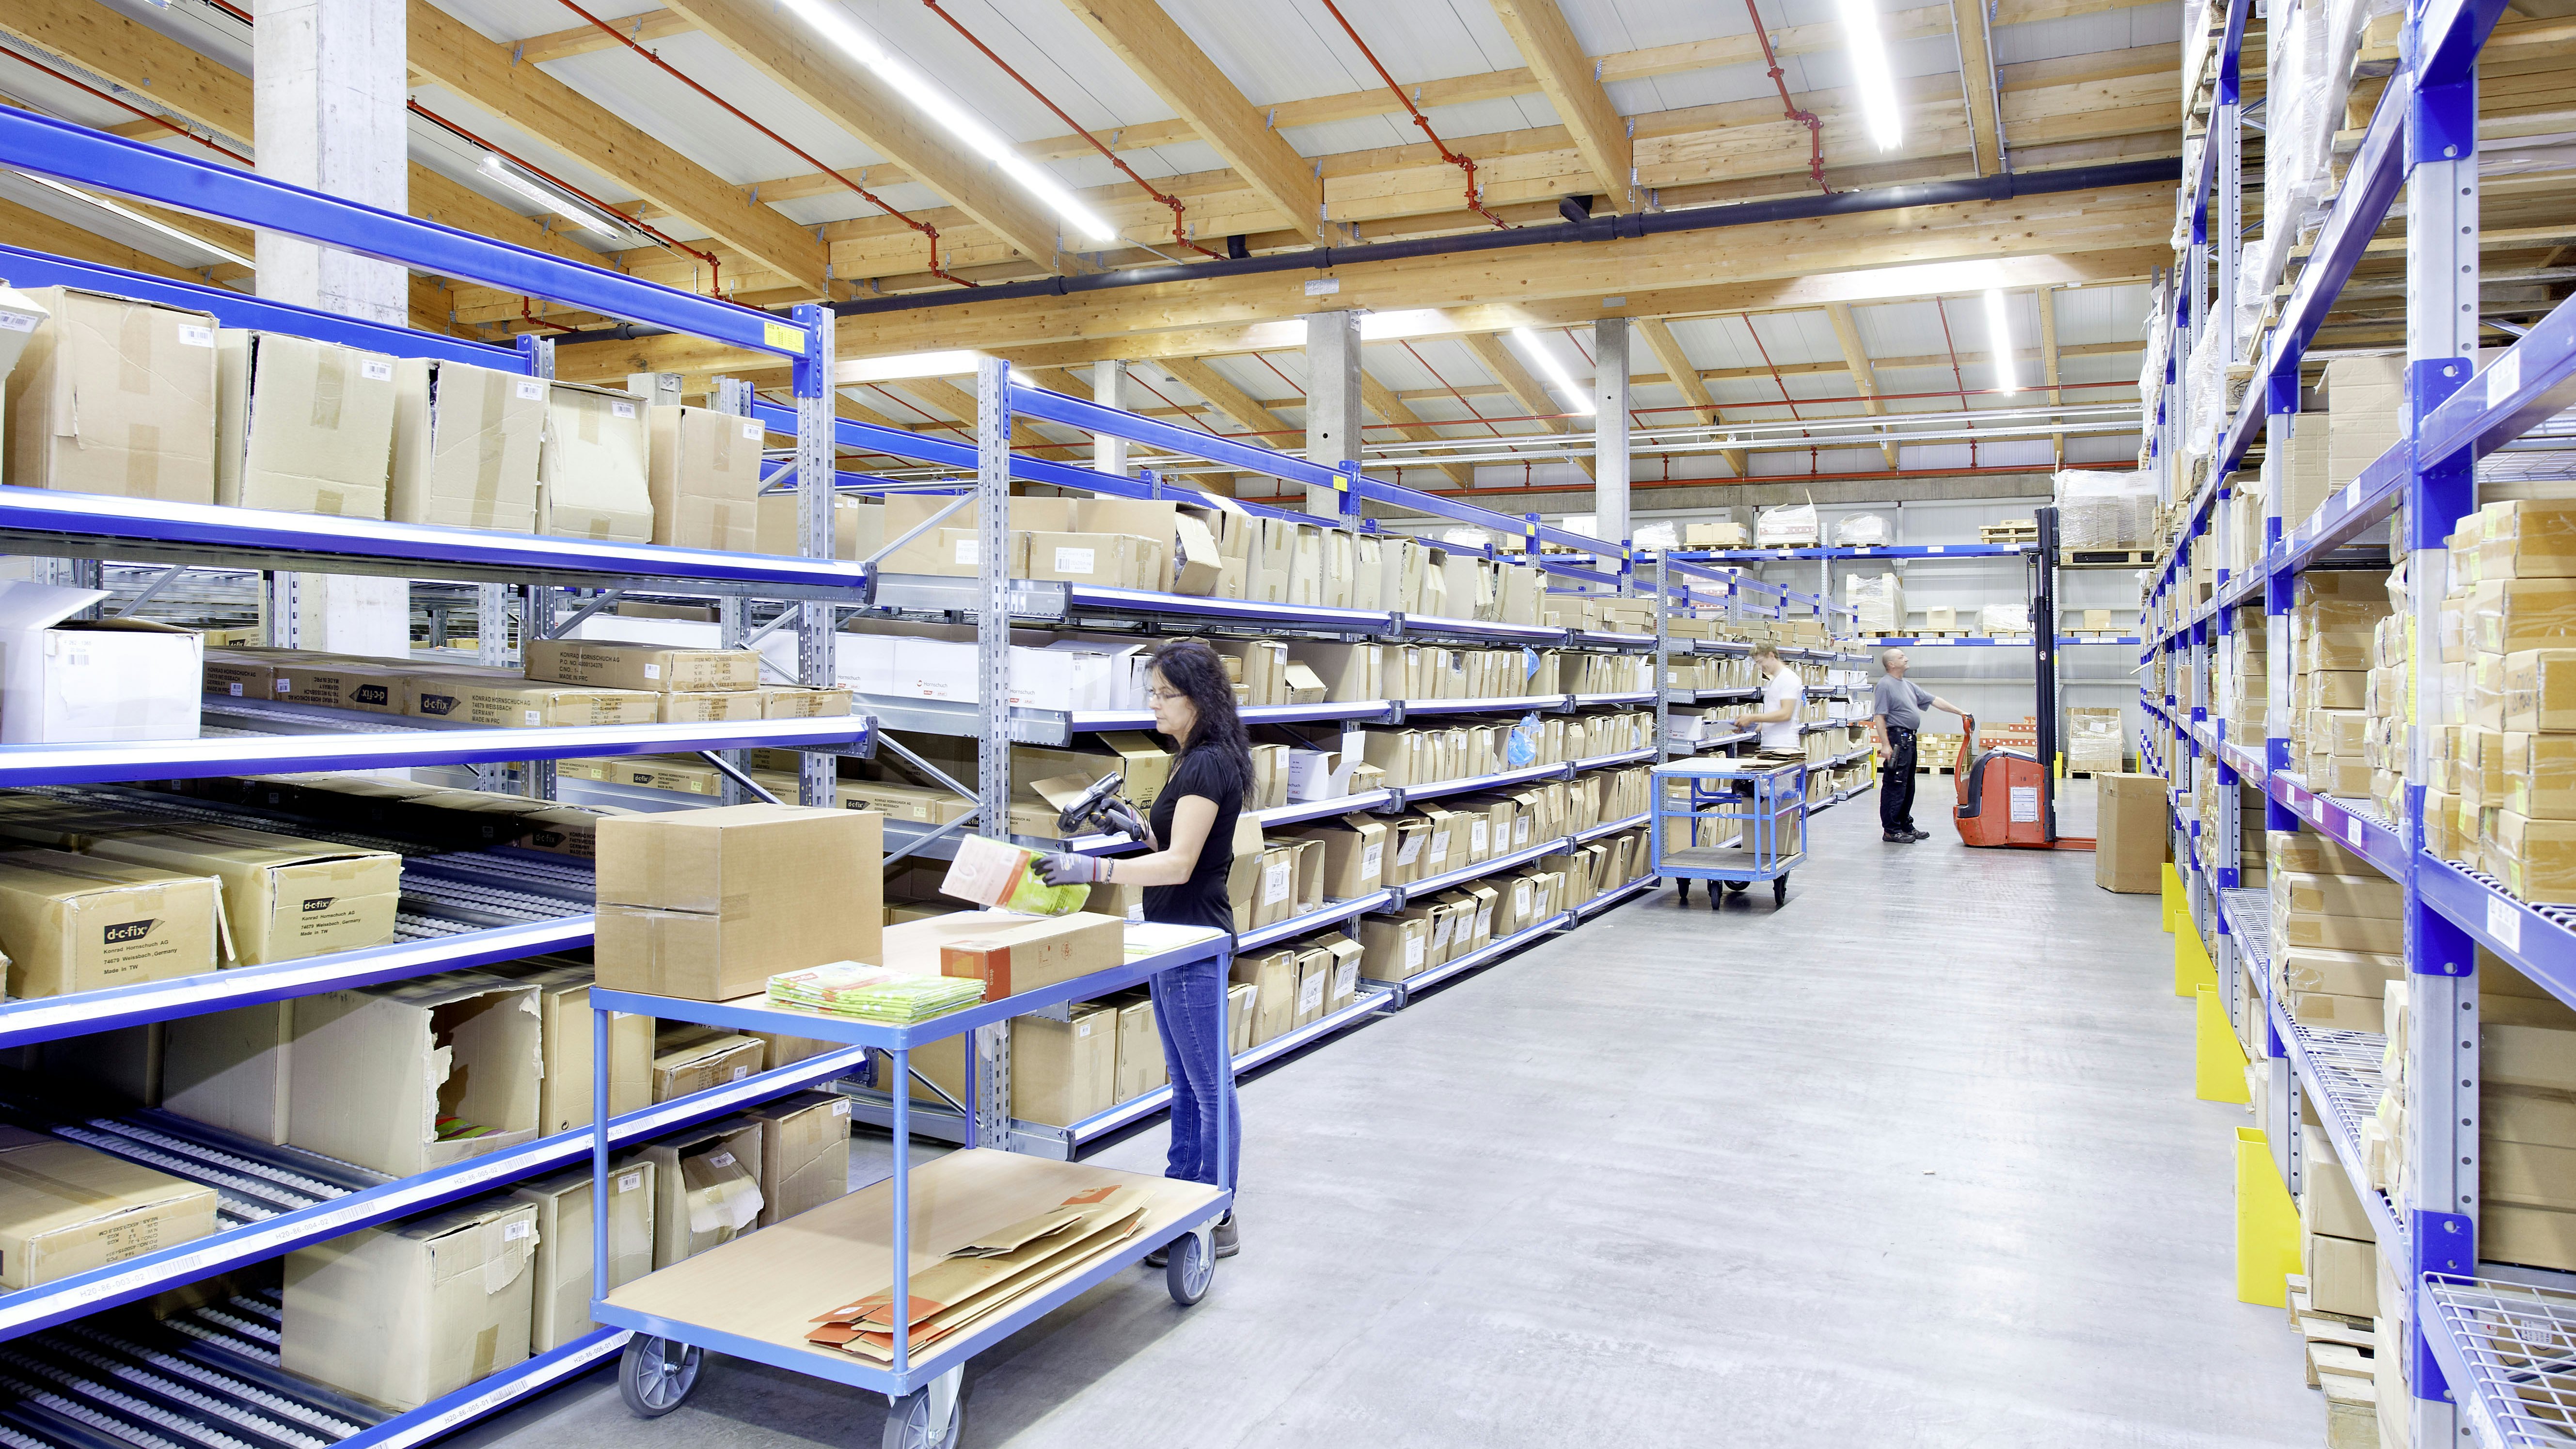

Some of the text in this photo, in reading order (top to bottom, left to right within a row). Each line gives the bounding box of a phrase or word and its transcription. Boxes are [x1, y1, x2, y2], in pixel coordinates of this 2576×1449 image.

[581, 654, 612, 662] HORNSCHUCH
[362, 689, 384, 701] d-c-fix
[424, 698, 447, 710] d-c-fix
[304, 900, 327, 909] d-c-fix
[107, 925, 145, 940] d-c-fix
[126, 942, 158, 950] Hornschuch
[454, 1167, 498, 1185] H20-86-005-02
[275, 1218, 329, 1240] H20-86-004-02
[80, 1273, 145, 1298] H20-86-003-02
[573, 1342, 612, 1364] H20-86-006-01
[444, 1399, 489, 1424] H20-86-005-01
